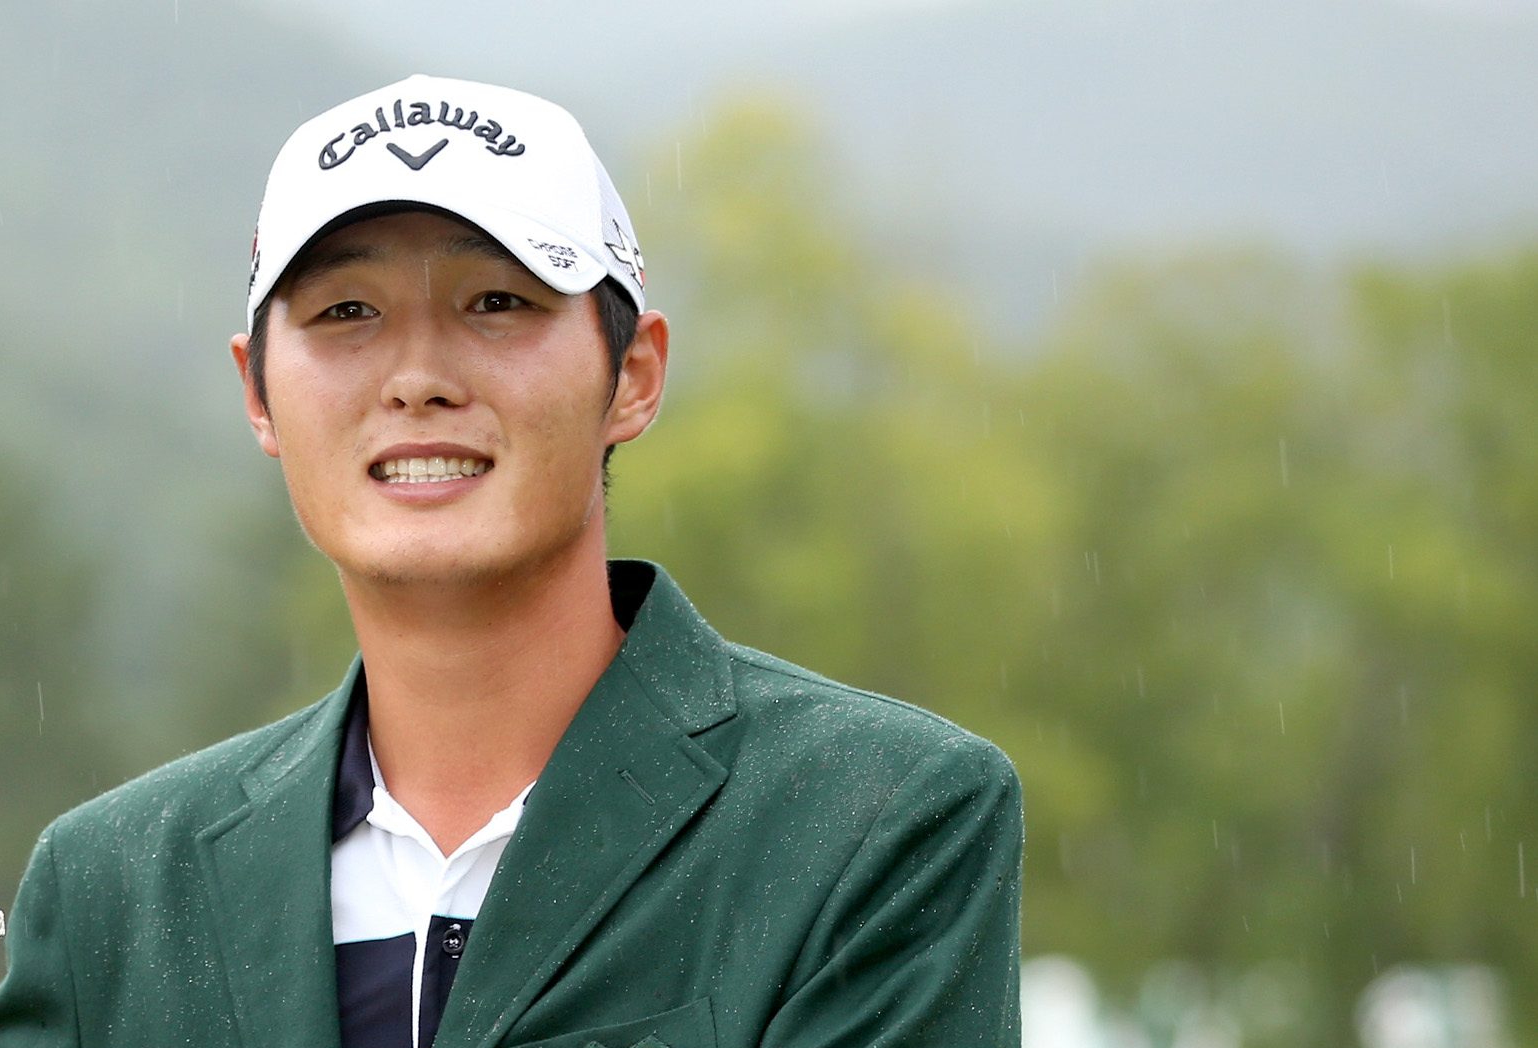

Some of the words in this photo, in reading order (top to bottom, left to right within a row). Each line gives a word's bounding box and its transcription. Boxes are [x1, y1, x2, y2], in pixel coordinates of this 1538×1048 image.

[318, 99, 525, 170] Callaway
[526, 238, 578, 258] CHROME
[547, 254, 579, 272] SOFT
